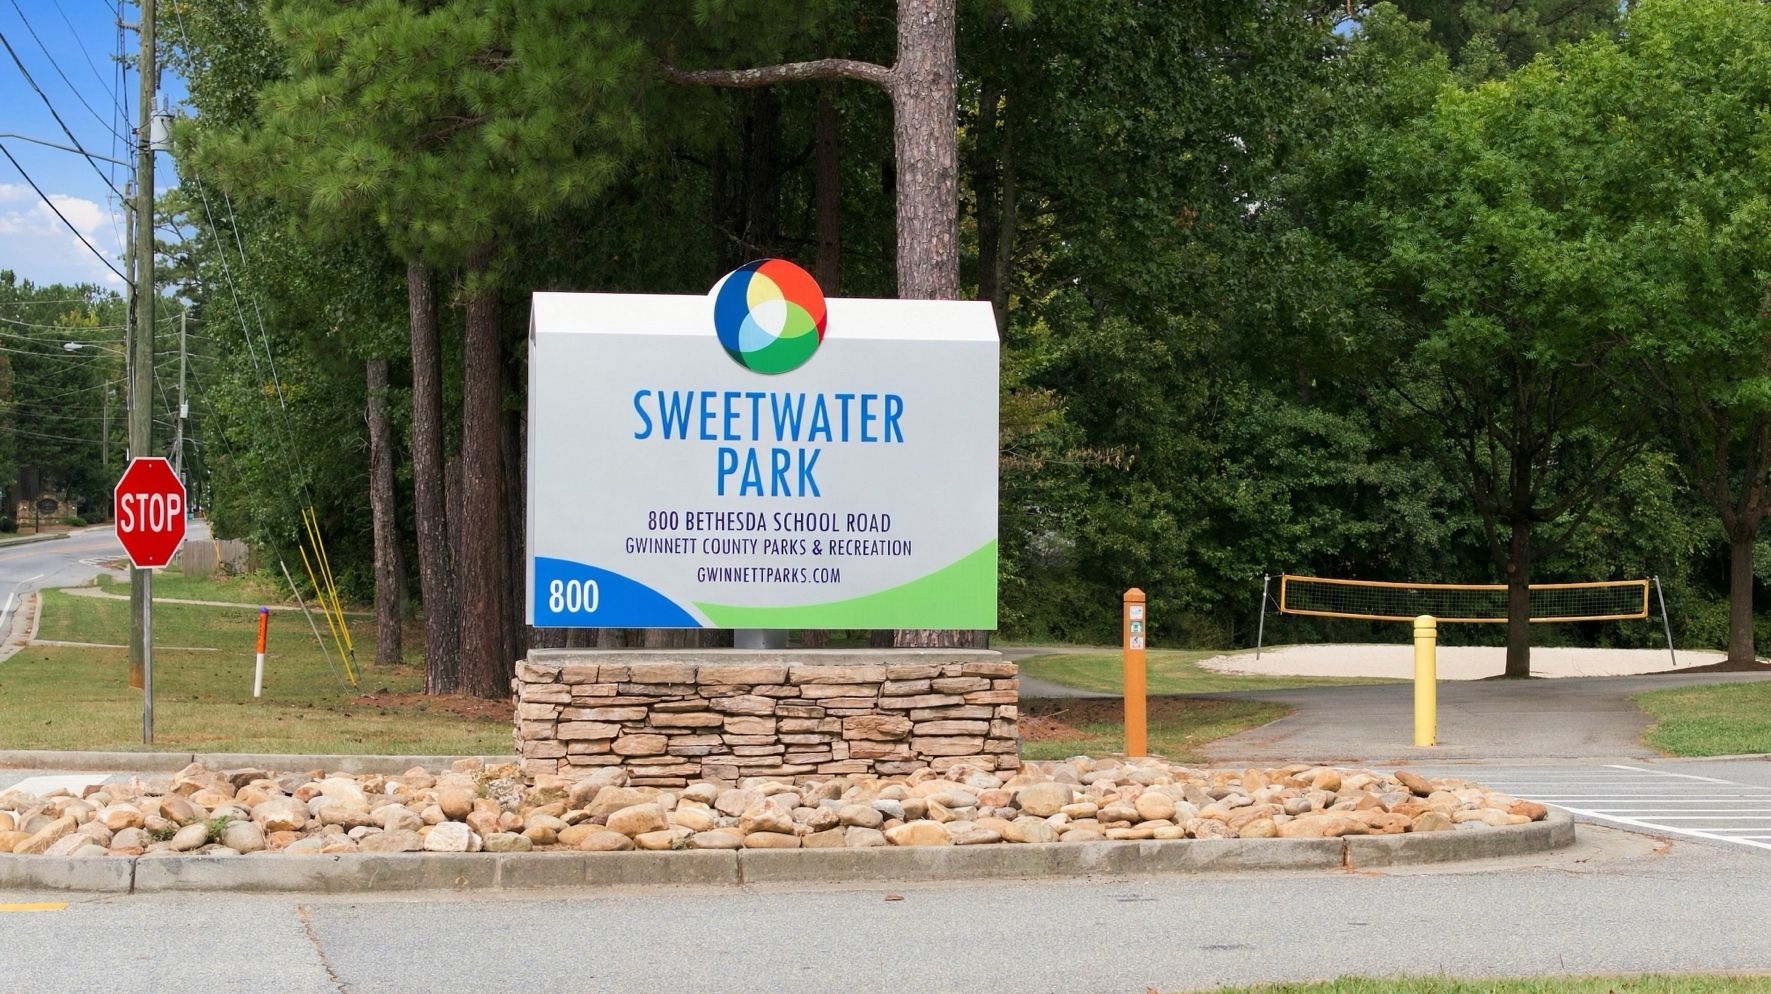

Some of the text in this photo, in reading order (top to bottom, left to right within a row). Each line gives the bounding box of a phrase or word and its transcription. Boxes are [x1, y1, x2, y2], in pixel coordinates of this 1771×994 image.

[633, 389, 905, 443] SWEETWATER
[716, 446, 822, 498] PARK
[120, 493, 182, 533] STOP
[647, 511, 892, 533] 800 BETHESDA SCHOOL ROAD
[625, 537, 912, 556] GWINNETT COUNTY PARKS & RECREATION
[697, 566, 841, 584] GWINNETTPARKS.COM
[549, 579, 599, 613] 800
